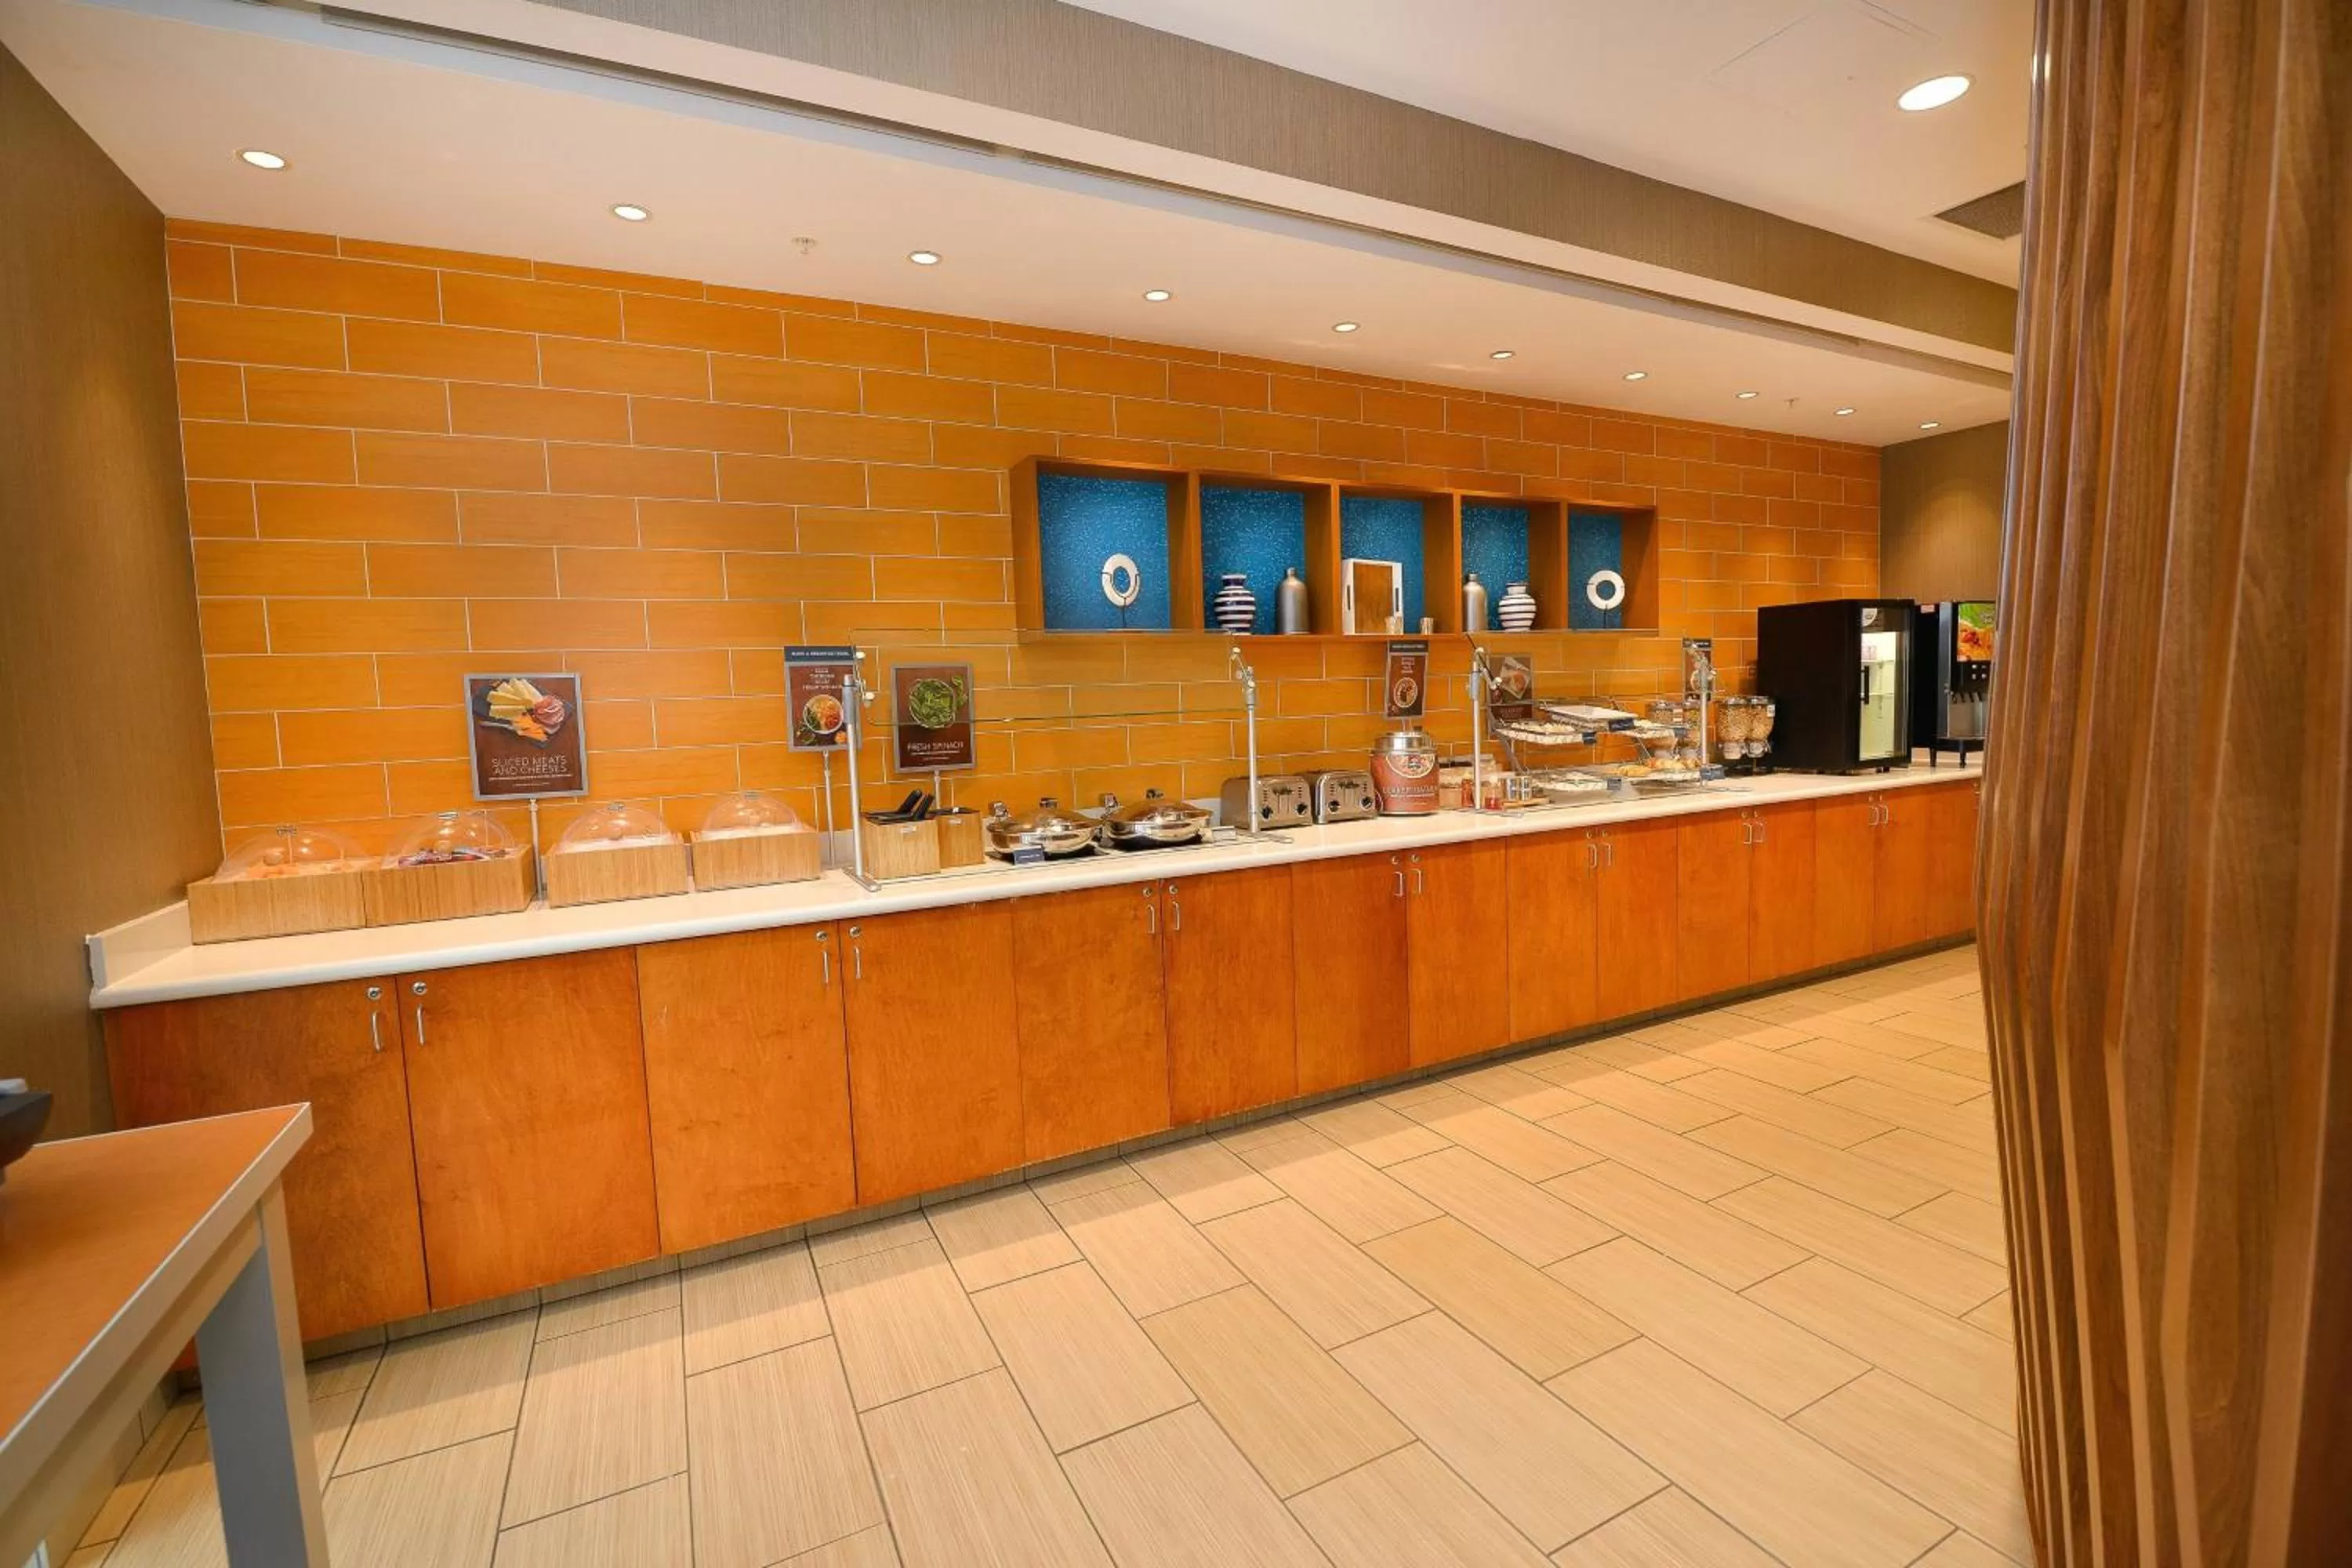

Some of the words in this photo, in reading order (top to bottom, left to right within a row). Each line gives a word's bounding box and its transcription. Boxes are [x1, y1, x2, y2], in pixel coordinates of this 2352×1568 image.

[492, 757, 529, 767] SLICED
[532, 755, 567, 766] MEATS
[494, 766, 518, 775] AND
[520, 765, 567, 775] CHEESES
